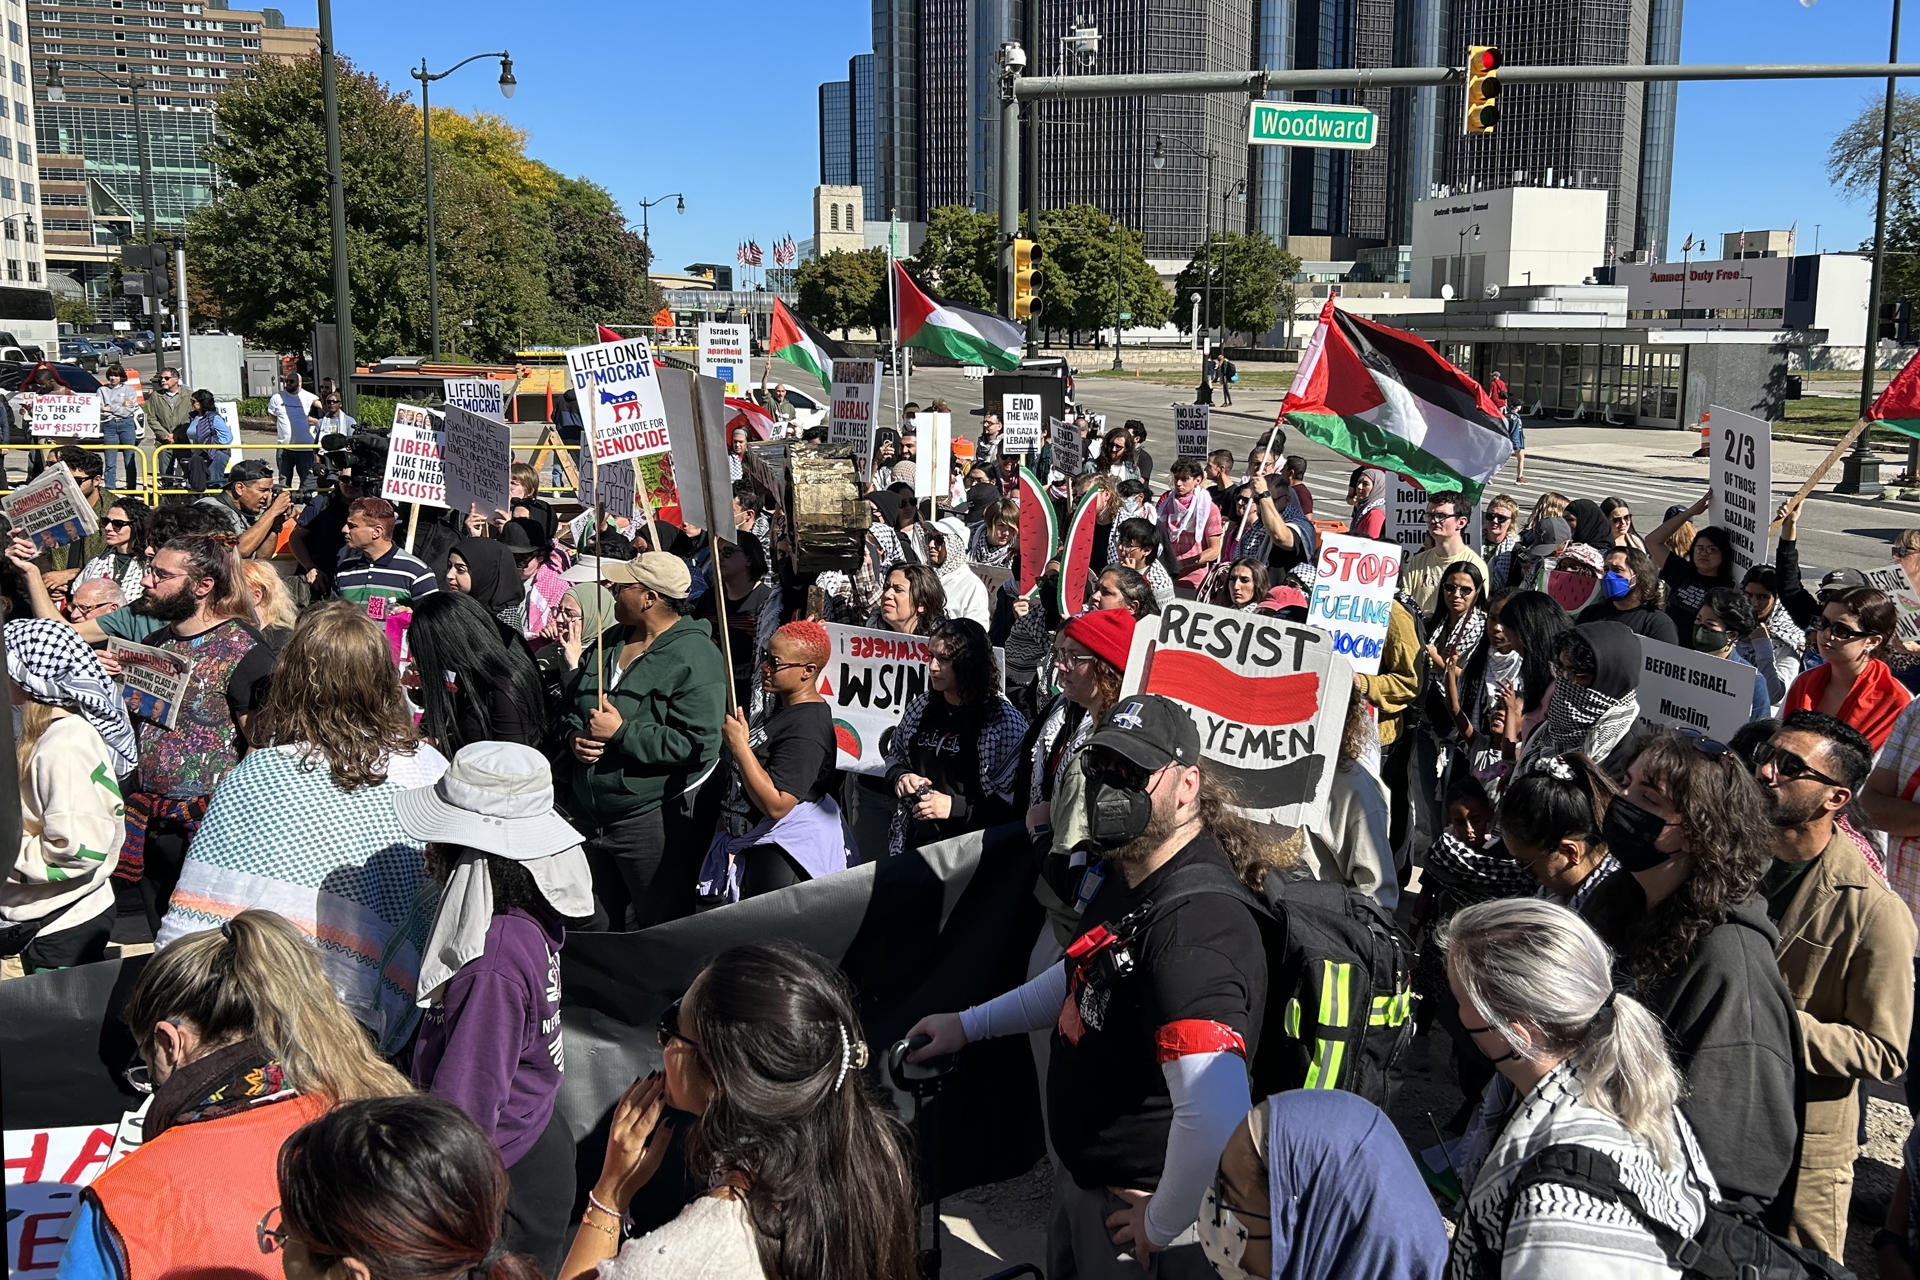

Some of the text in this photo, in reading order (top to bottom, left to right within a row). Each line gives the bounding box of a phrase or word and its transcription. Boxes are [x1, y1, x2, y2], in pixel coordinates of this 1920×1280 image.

[1262, 112, 1367, 139] Woodward
[1690, 270, 1713, 283] Duty
[1716, 270, 1739, 280] Free
[572, 343, 648, 372] LIFELONG
[67, 397, 91, 405] ELSE
[448, 384, 500, 398] LIFELONG
[846, 386, 859, 398] WITH
[48, 405, 81, 413] THERE
[834, 400, 869, 420] LIBERALS
[1013, 398, 1033, 410] END
[1176, 408, 1187, 418] NO
[462, 413, 497, 438] NO ONE
[596, 418, 664, 439] UT CAN'T VOTE FOR
[1006, 412, 1038, 421] THE WAR
[1177, 420, 1207, 430] ISRAELI
[416, 430, 437, 442] WITH
[447, 420, 504, 451] SHOULD HAVE TO
[834, 422, 867, 438] LIKE THESE
[1058, 428, 1073, 442] END
[1178, 435, 1207, 445] WAR ON
[394, 438, 446, 459] LIBERAL
[447, 442, 468, 458] LOVED
[448, 431, 489, 456] LIVESTREAM
[596, 428, 669, 458] GENOCIDE
[1054, 436, 1079, 452] WEAPONS
[1179, 446, 1207, 454] LEBANON
[1724, 429, 1755, 470] 2/3
[396, 455, 416, 468] LIKE
[460, 457, 500, 481] TO PROVE
[392, 467, 445, 485] WHO NEED
[448, 462, 504, 494] THEY DESERVE
[460, 479, 471, 491] TO
[1724, 471, 1756, 495] OF THOSE
[13, 486, 55, 512] COMMUNIST
[28, 508, 48, 523] RULING
[48, 503, 62, 515] CLASS
[63, 499, 71, 507] IN
[1724, 490, 1756, 515] KILLED IN
[26, 518, 53, 533] TERMINAL
[53, 508, 76, 522] DECLINE
[1724, 508, 1756, 534] GAZA ARE
[1724, 526, 1754, 554] WOMEN &
[1318, 547, 1400, 588] STOP
[1732, 550, 1753, 570] ILDREN
[1310, 585, 1390, 628] FUELING
[1158, 604, 1321, 671] RESIST
[1328, 630, 1384, 659] NOCIDE
[118, 648, 173, 673] COMMUNIST
[127, 675, 175, 700] TERMINAL DECLINE
[134, 667, 154, 681] RULING
[154, 675, 171, 688] CLASS
[171, 682, 179, 691] IN
[1645, 656, 1736, 698] BEFORE ISRAEL...
[1660, 698, 1710, 731] Muslim,
[1206, 716, 1315, 761] YEMEN
